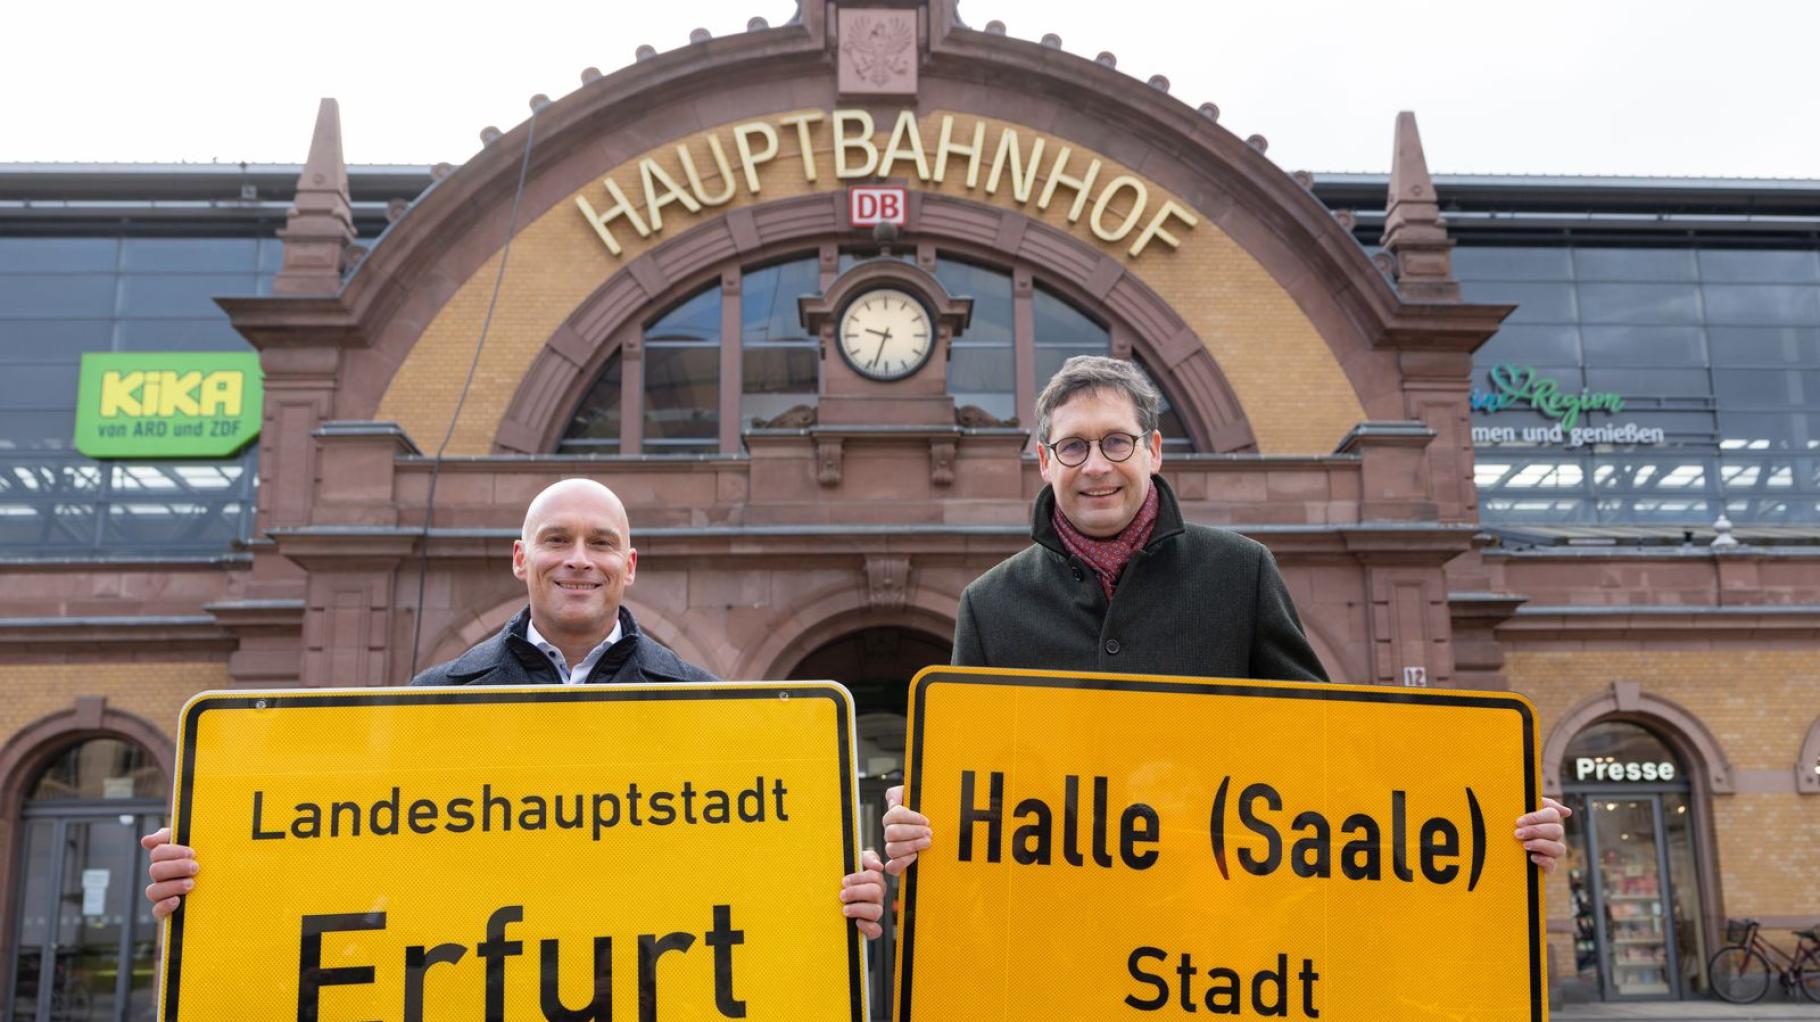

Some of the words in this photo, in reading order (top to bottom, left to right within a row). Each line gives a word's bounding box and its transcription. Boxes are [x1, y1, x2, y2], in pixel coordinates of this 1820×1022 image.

[575, 109, 1198, 258] HAUPTBAHNHOF
[858, 194, 899, 219] DB
[97, 424, 127, 437] von
[132, 421, 167, 437] ARD
[173, 422, 203, 437] und
[209, 420, 242, 437] ZDF
[1531, 378, 1624, 432] Region
[1523, 423, 1563, 442] und
[1570, 422, 1664, 447] genießen
[1407, 669, 1424, 686] 12
[1576, 757, 1675, 781] Presse
[251, 776, 789, 841] Landeshauptstadt
[958, 770, 1160, 870] Halle
[1210, 776, 1487, 891] (Saale)
[297, 904, 748, 1022] Erfurt
[1124, 946, 1320, 1018] Stadt
